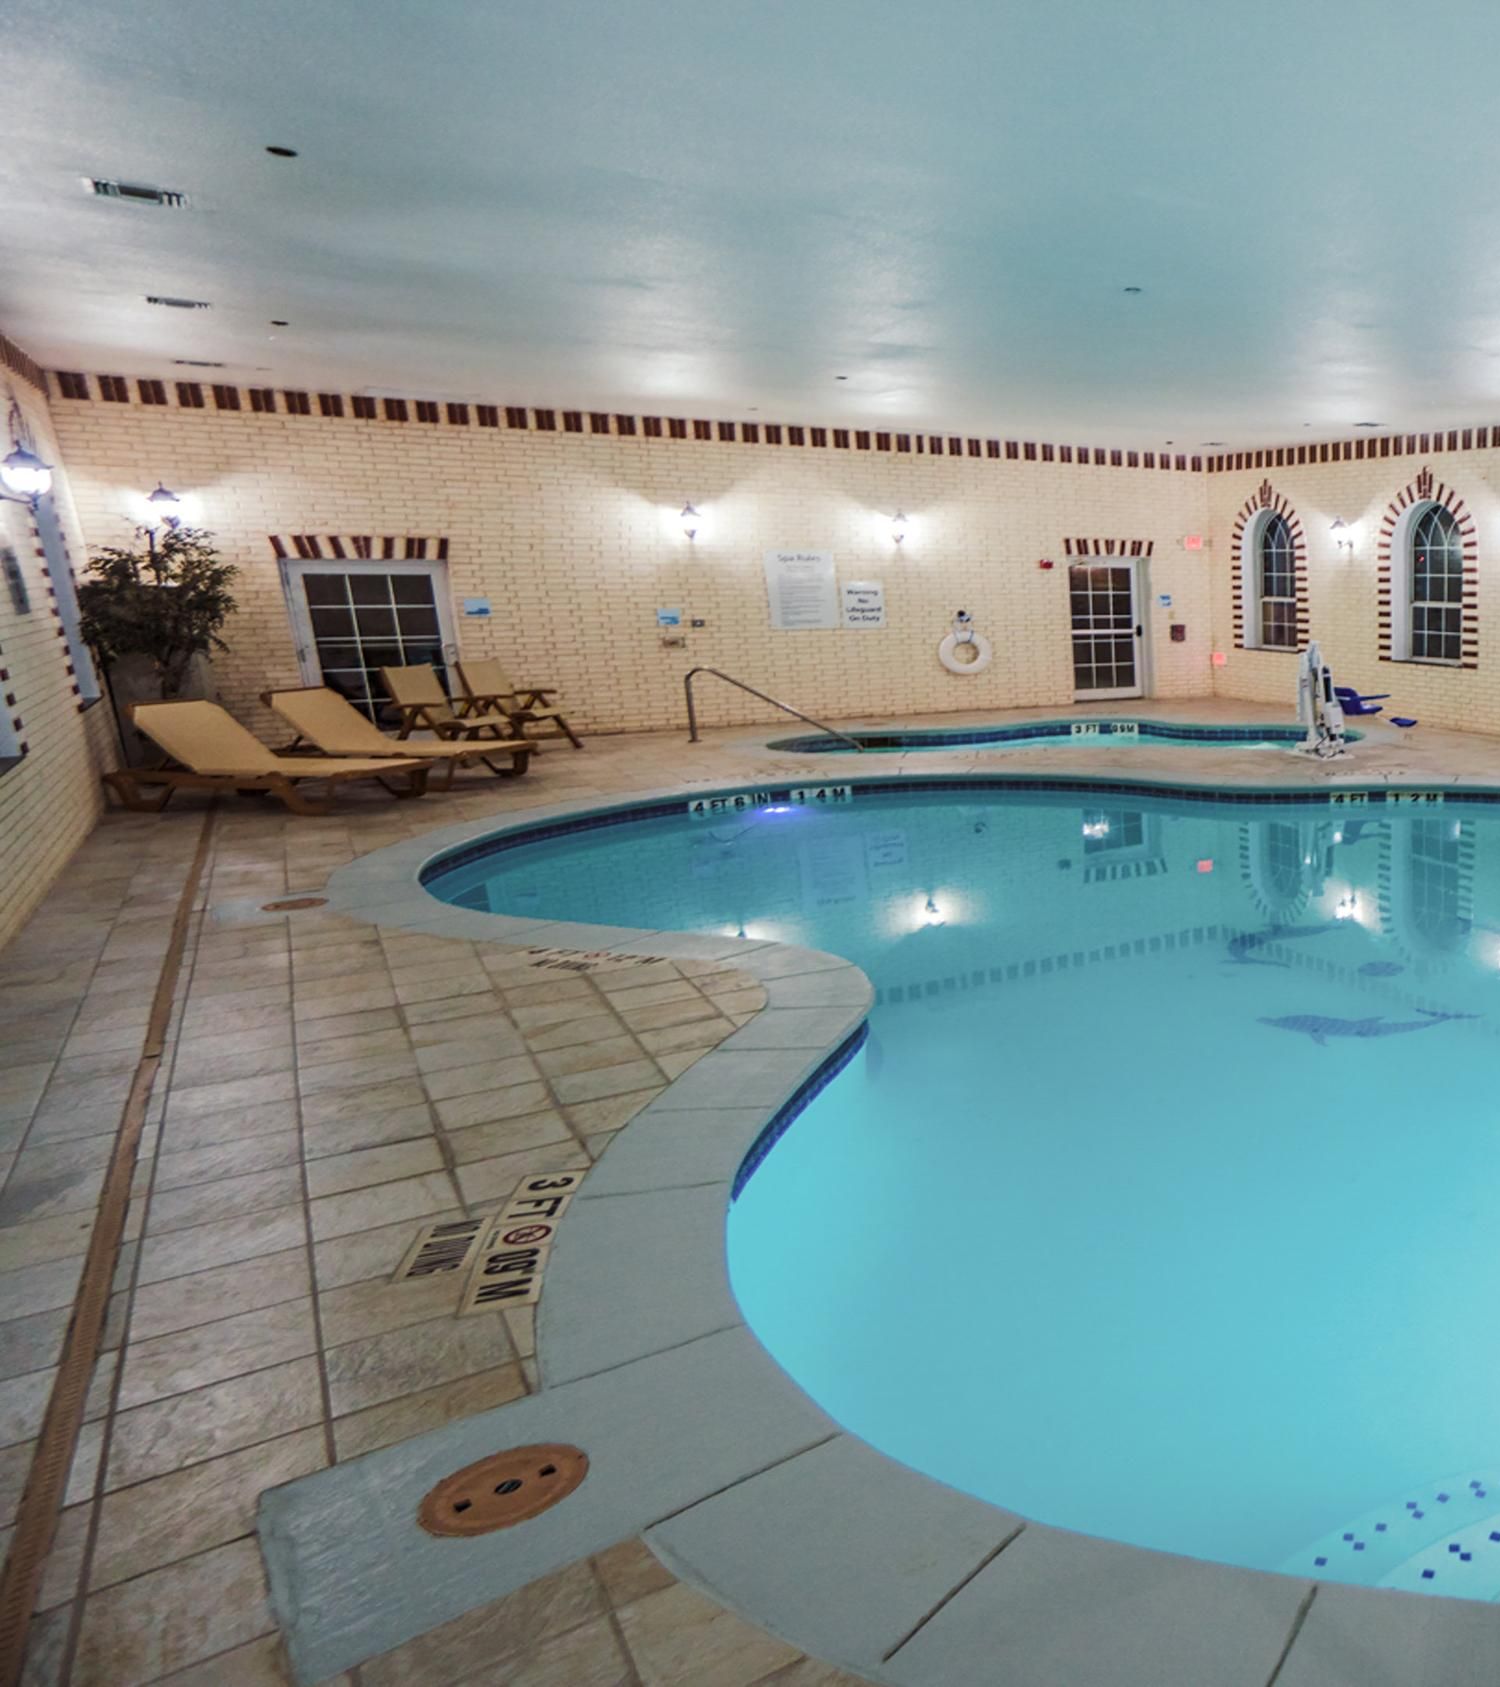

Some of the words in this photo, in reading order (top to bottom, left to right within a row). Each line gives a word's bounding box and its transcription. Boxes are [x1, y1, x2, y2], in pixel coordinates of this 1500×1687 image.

[1086, 724, 1097, 733] FT
[710, 797, 728, 809] FT
[752, 793, 769, 805] IN
[1350, 793, 1366, 803] FT
[528, 1176, 574, 1191] 3
[507, 1196, 565, 1219] FT
